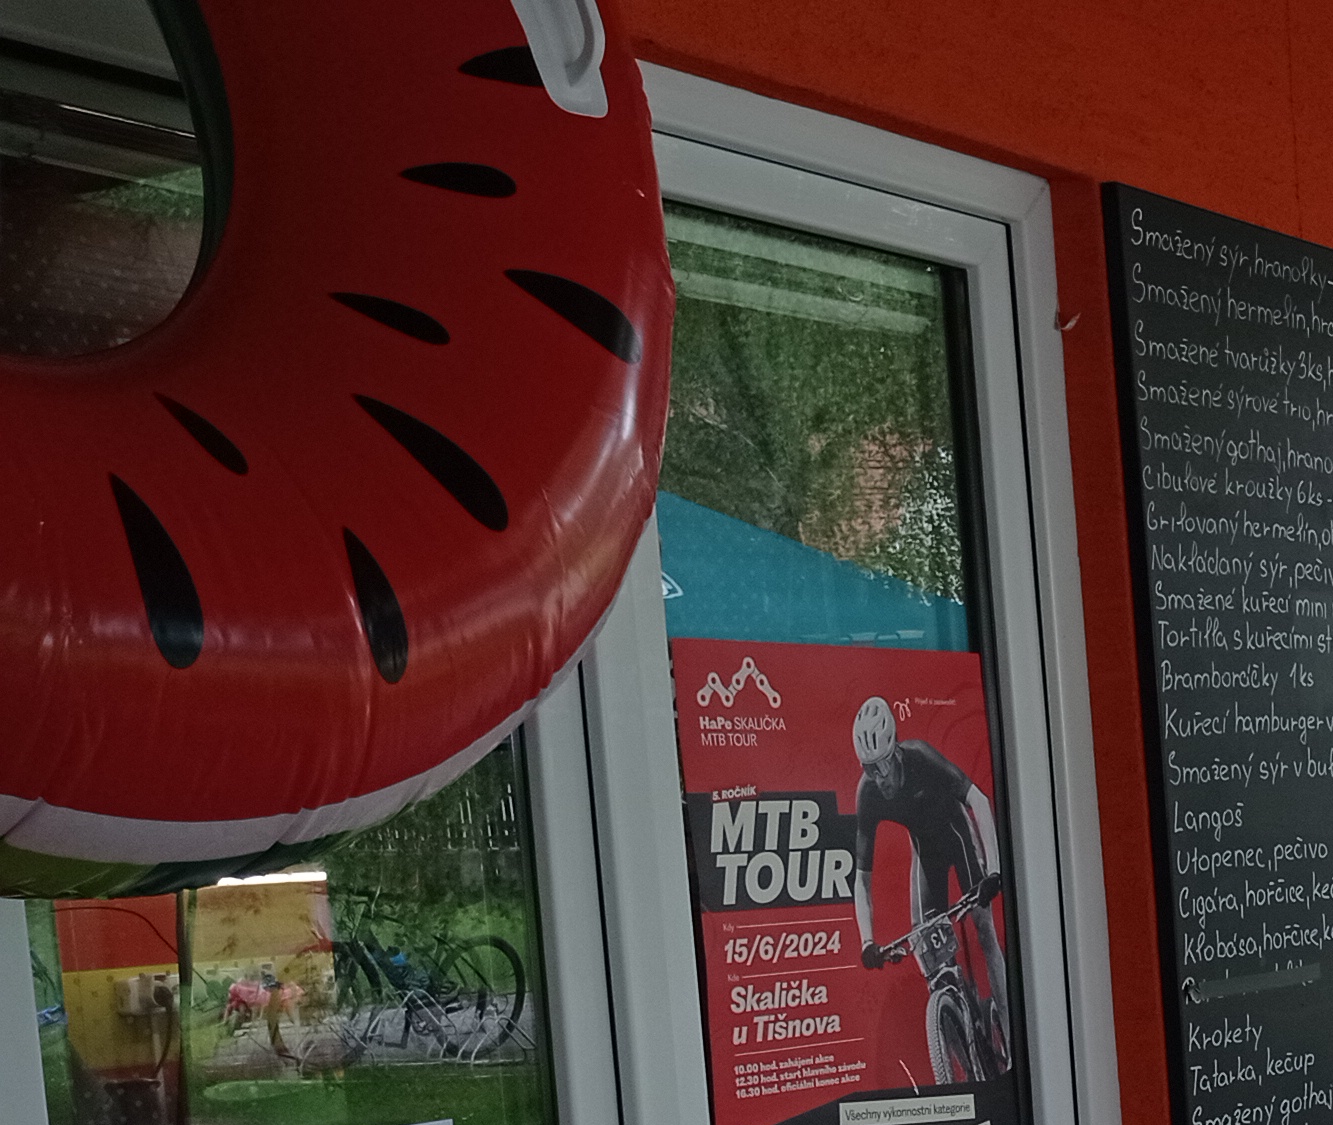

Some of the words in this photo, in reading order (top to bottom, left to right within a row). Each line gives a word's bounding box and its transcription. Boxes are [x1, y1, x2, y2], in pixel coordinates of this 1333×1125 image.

[701, 733, 726, 746] MTB
[728, 733, 758, 746] TOUR
[734, 715, 786, 730] SKALIČKA
[711, 800, 819, 853] MTB
[1173, 801, 1244, 841] Langoš
[716, 850, 853, 905] TOUR
[724, 930, 841, 965] 15/6/2024
[730, 979, 828, 1013] Skalička
[732, 1023, 748, 1045] u
[753, 1012, 841, 1043] Tišnova
[1188, 1013, 1262, 1052] Krokety
